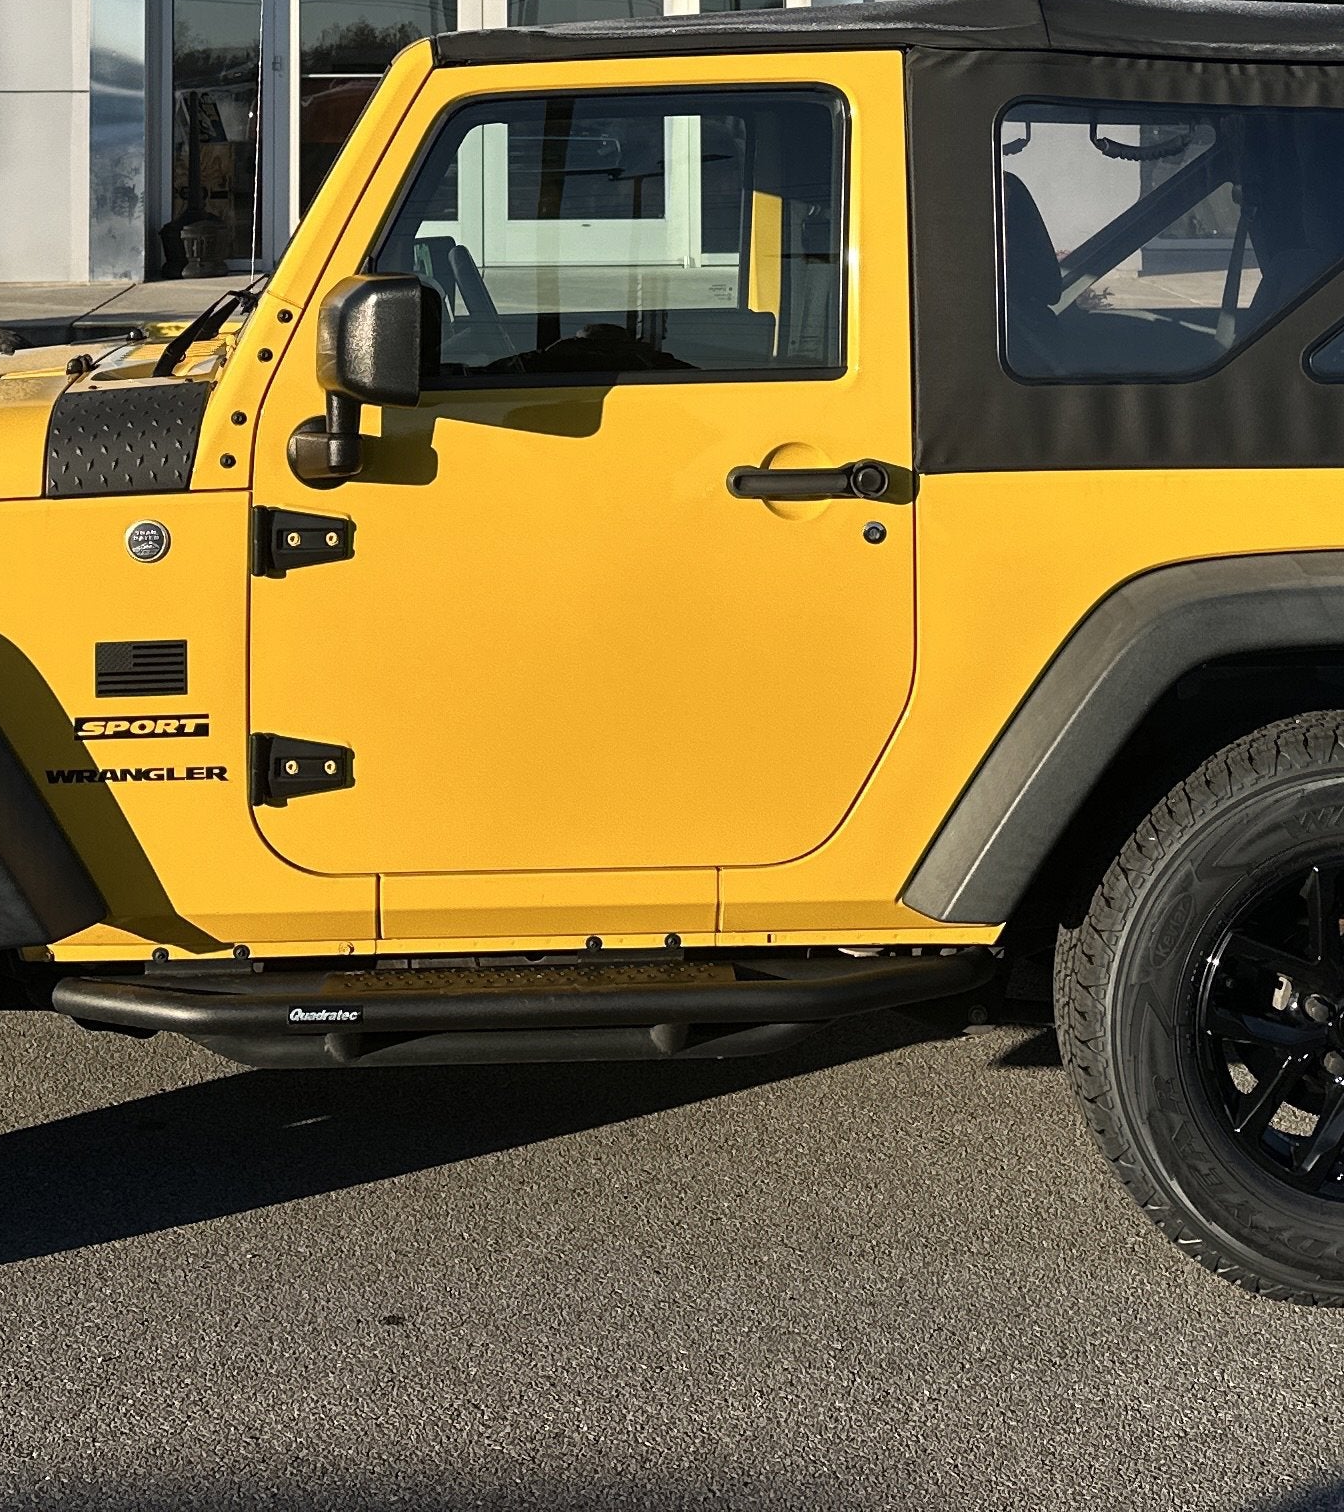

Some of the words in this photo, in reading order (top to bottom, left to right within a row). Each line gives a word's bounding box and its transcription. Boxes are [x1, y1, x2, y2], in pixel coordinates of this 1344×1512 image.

[77, 718, 209, 736] SPORT
[46, 766, 229, 784] WRANGLER
[1156, 899, 1189, 958] Kevlar
[289, 1008, 360, 1022] Quadratec
